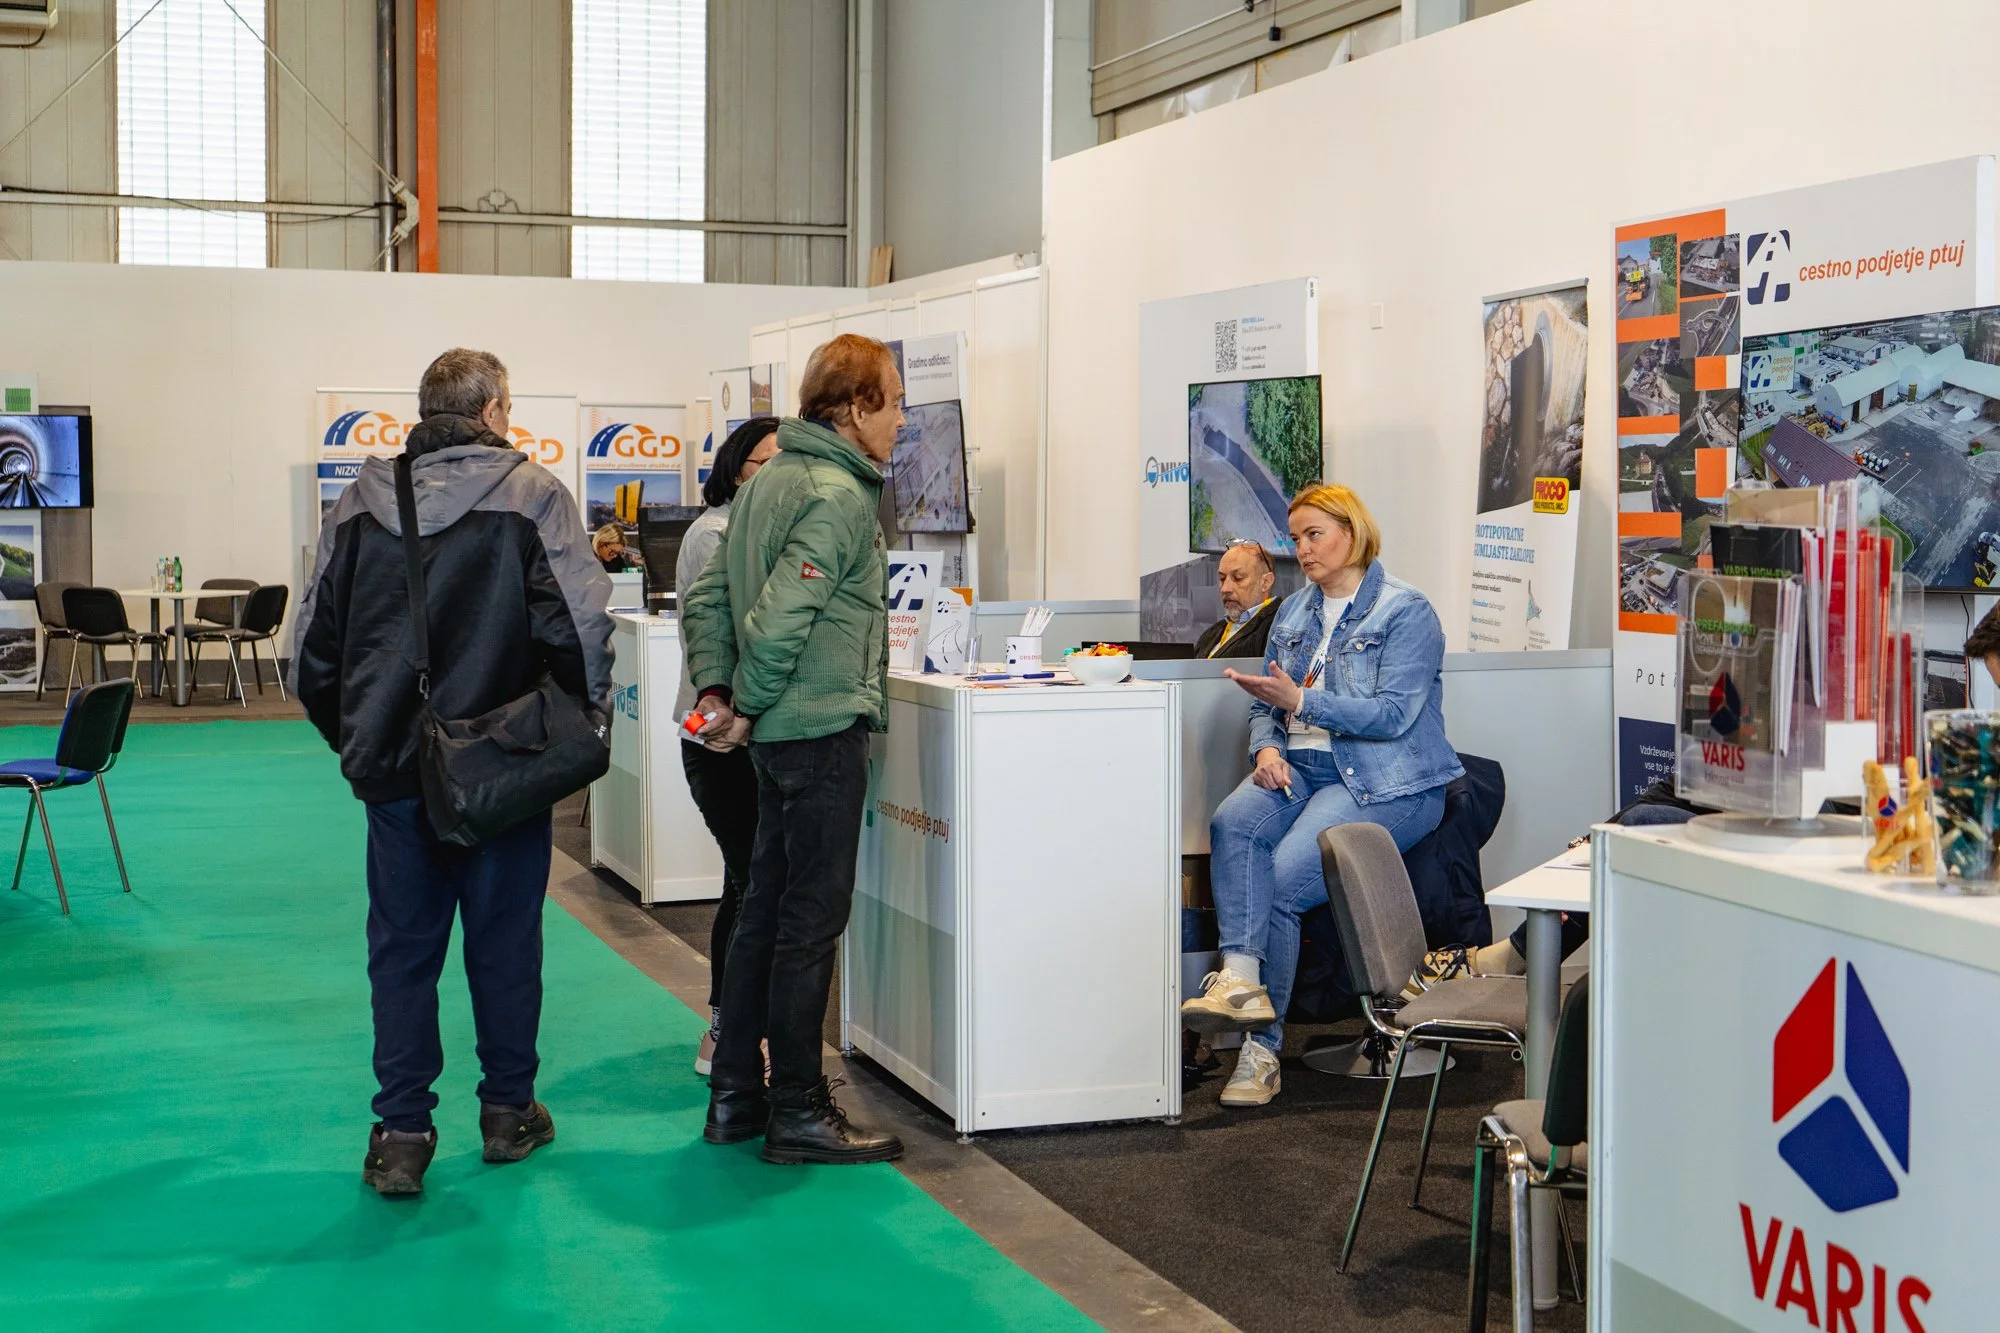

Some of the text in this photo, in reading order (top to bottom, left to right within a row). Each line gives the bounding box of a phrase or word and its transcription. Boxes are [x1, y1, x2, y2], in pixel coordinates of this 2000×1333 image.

[1799, 239, 1966, 282] cestno podjetje ptuj
[614, 435, 681, 458] GGD
[888, 626, 920, 637] odjetje
[1644, 761, 1655, 771] vse
[1656, 761, 1663, 772] to
[1663, 763, 1670, 775] je
[1700, 739, 1746, 772] VARIS
[876, 799, 950, 844] cestno podjetje ptuj
[1738, 1201, 1933, 1333] VARIS
